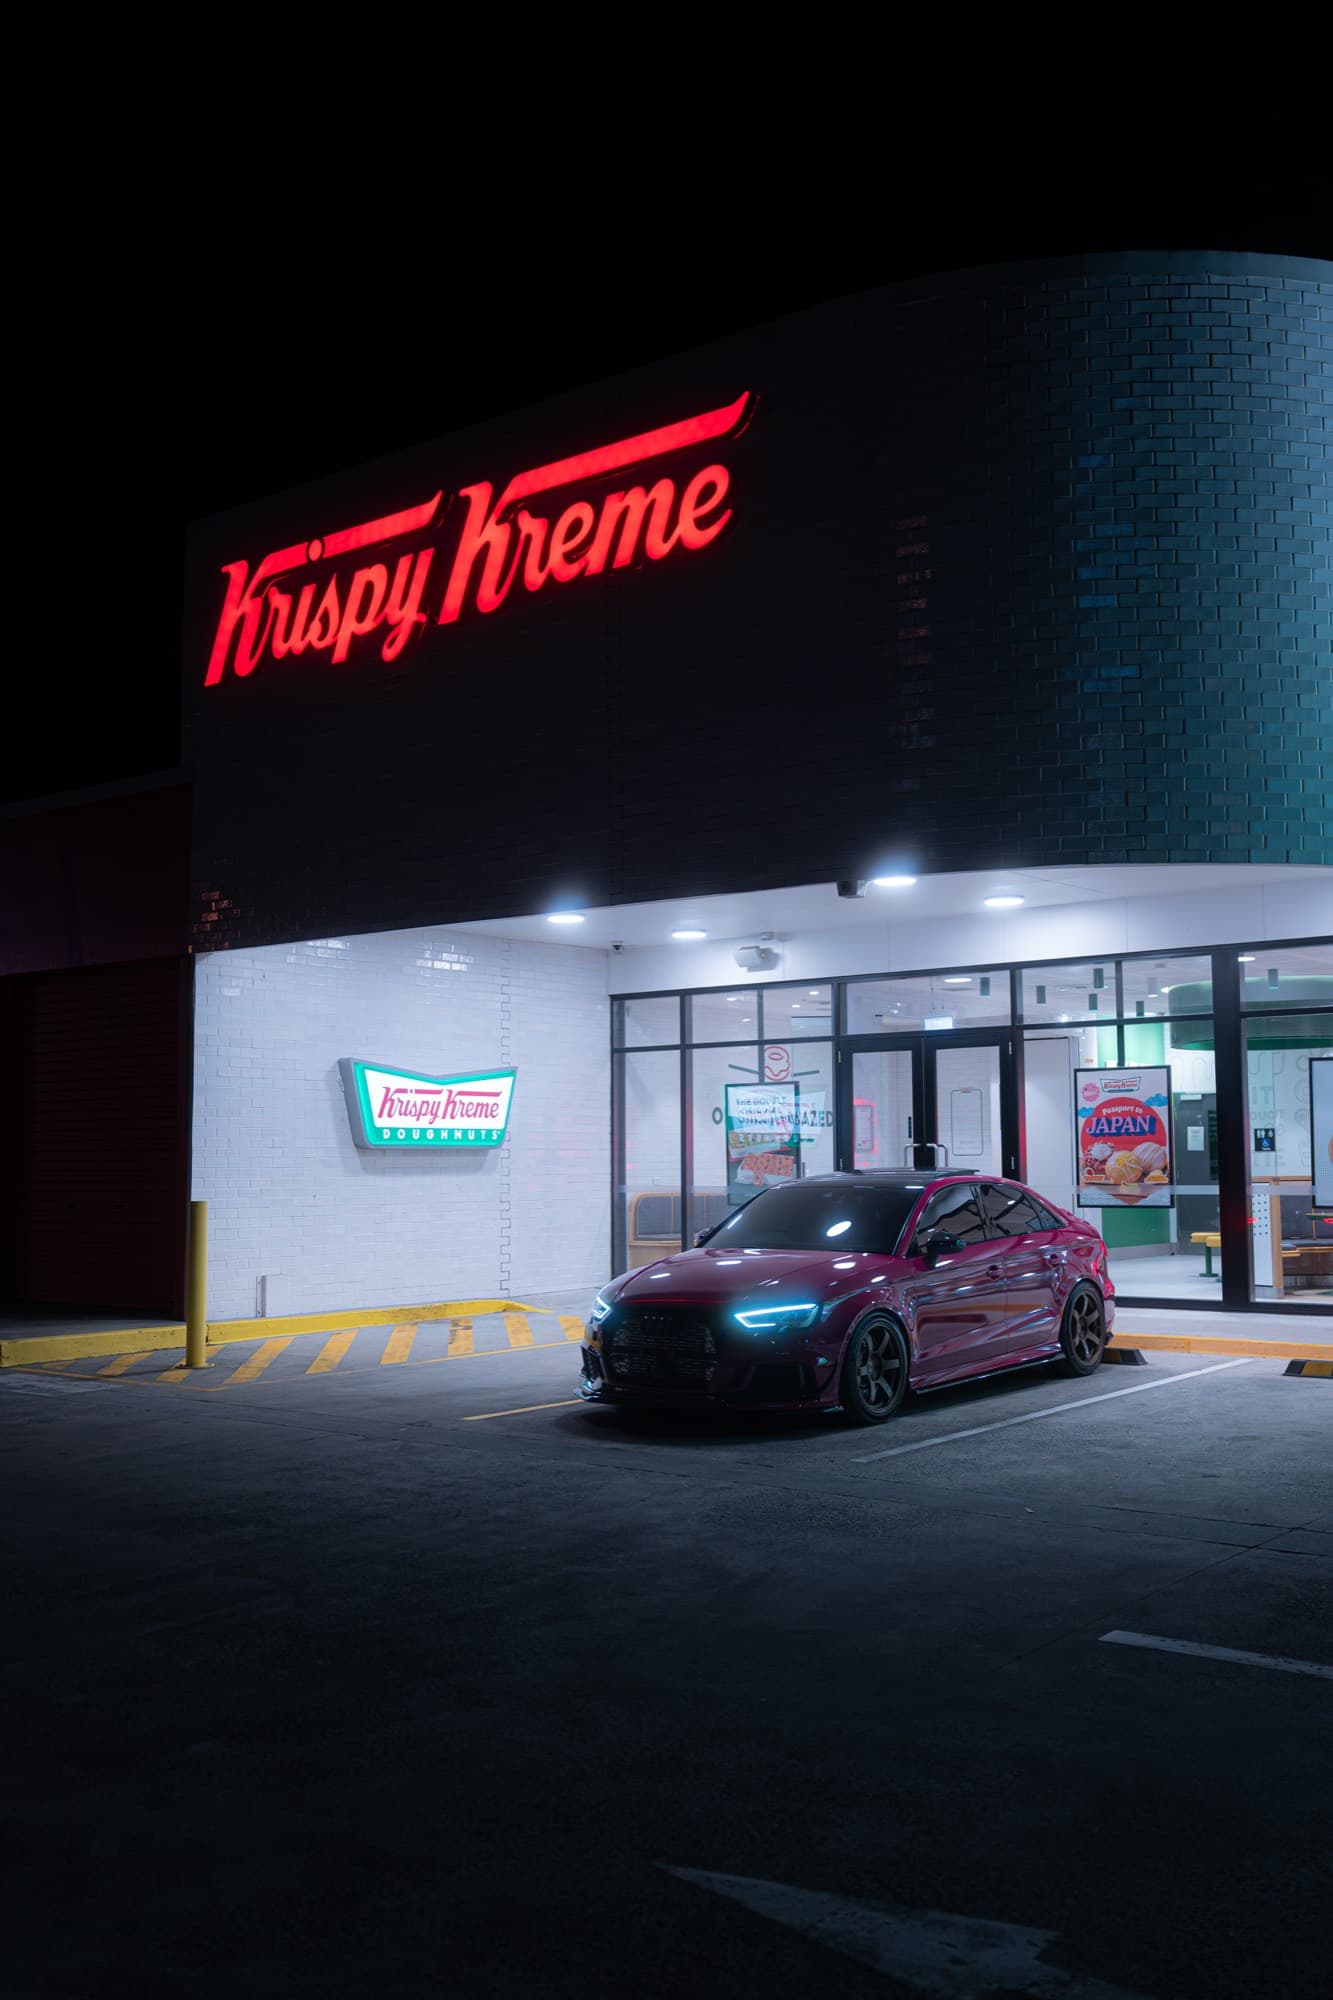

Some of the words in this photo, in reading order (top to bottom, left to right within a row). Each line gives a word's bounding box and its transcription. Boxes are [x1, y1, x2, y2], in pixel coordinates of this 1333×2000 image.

[204, 489, 443, 687] Krispy
[439, 390, 749, 625] Kreme
[377, 1086, 443, 1125] Krispy
[441, 1088, 502, 1119] Kreme
[1102, 1105, 1134, 1115] Passport
[1135, 1105, 1143, 1114] to
[383, 1128, 499, 1139] DOUGHNUTS
[1086, 1114, 1153, 1136] JAPAN
